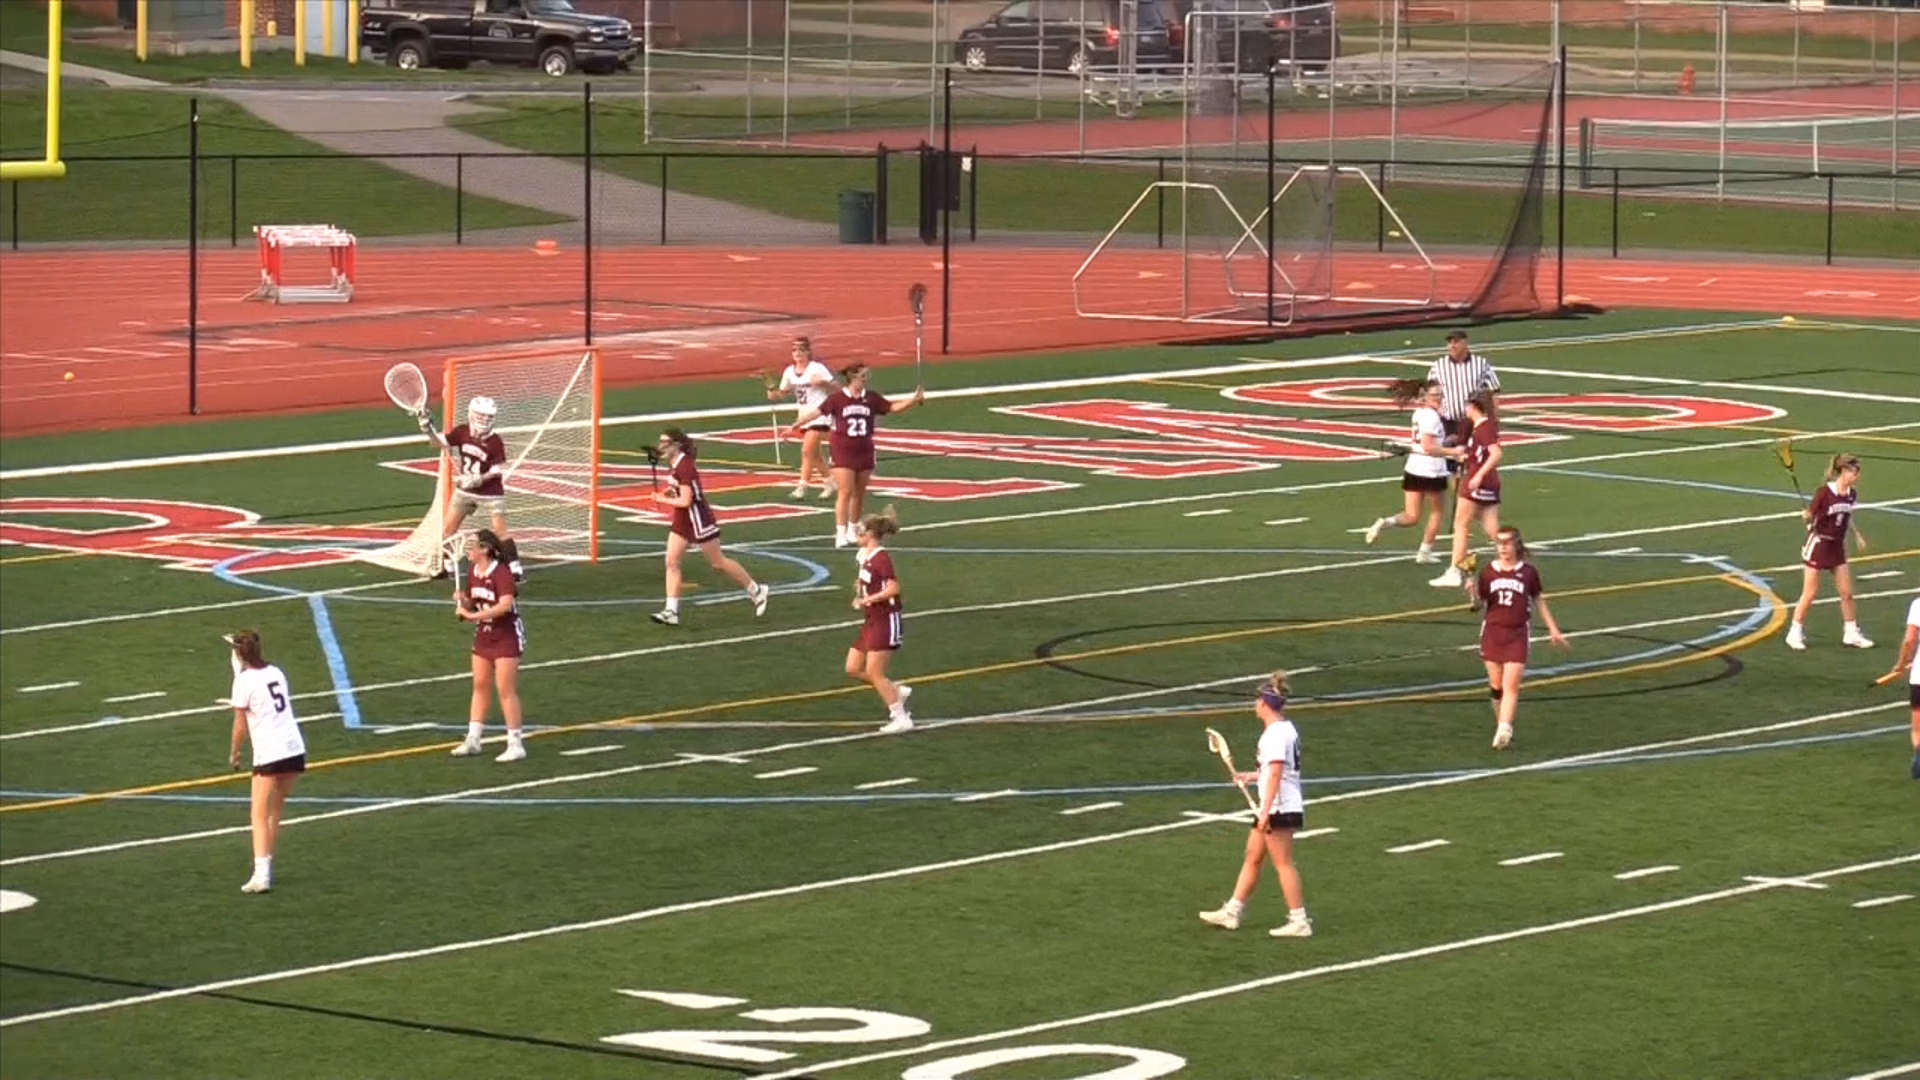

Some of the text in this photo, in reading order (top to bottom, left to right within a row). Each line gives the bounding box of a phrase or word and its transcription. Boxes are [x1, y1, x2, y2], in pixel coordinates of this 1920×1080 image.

[847, 418, 867, 437] 23
[1498, 590, 1513, 606] 12
[267, 681, 286, 713] 5
